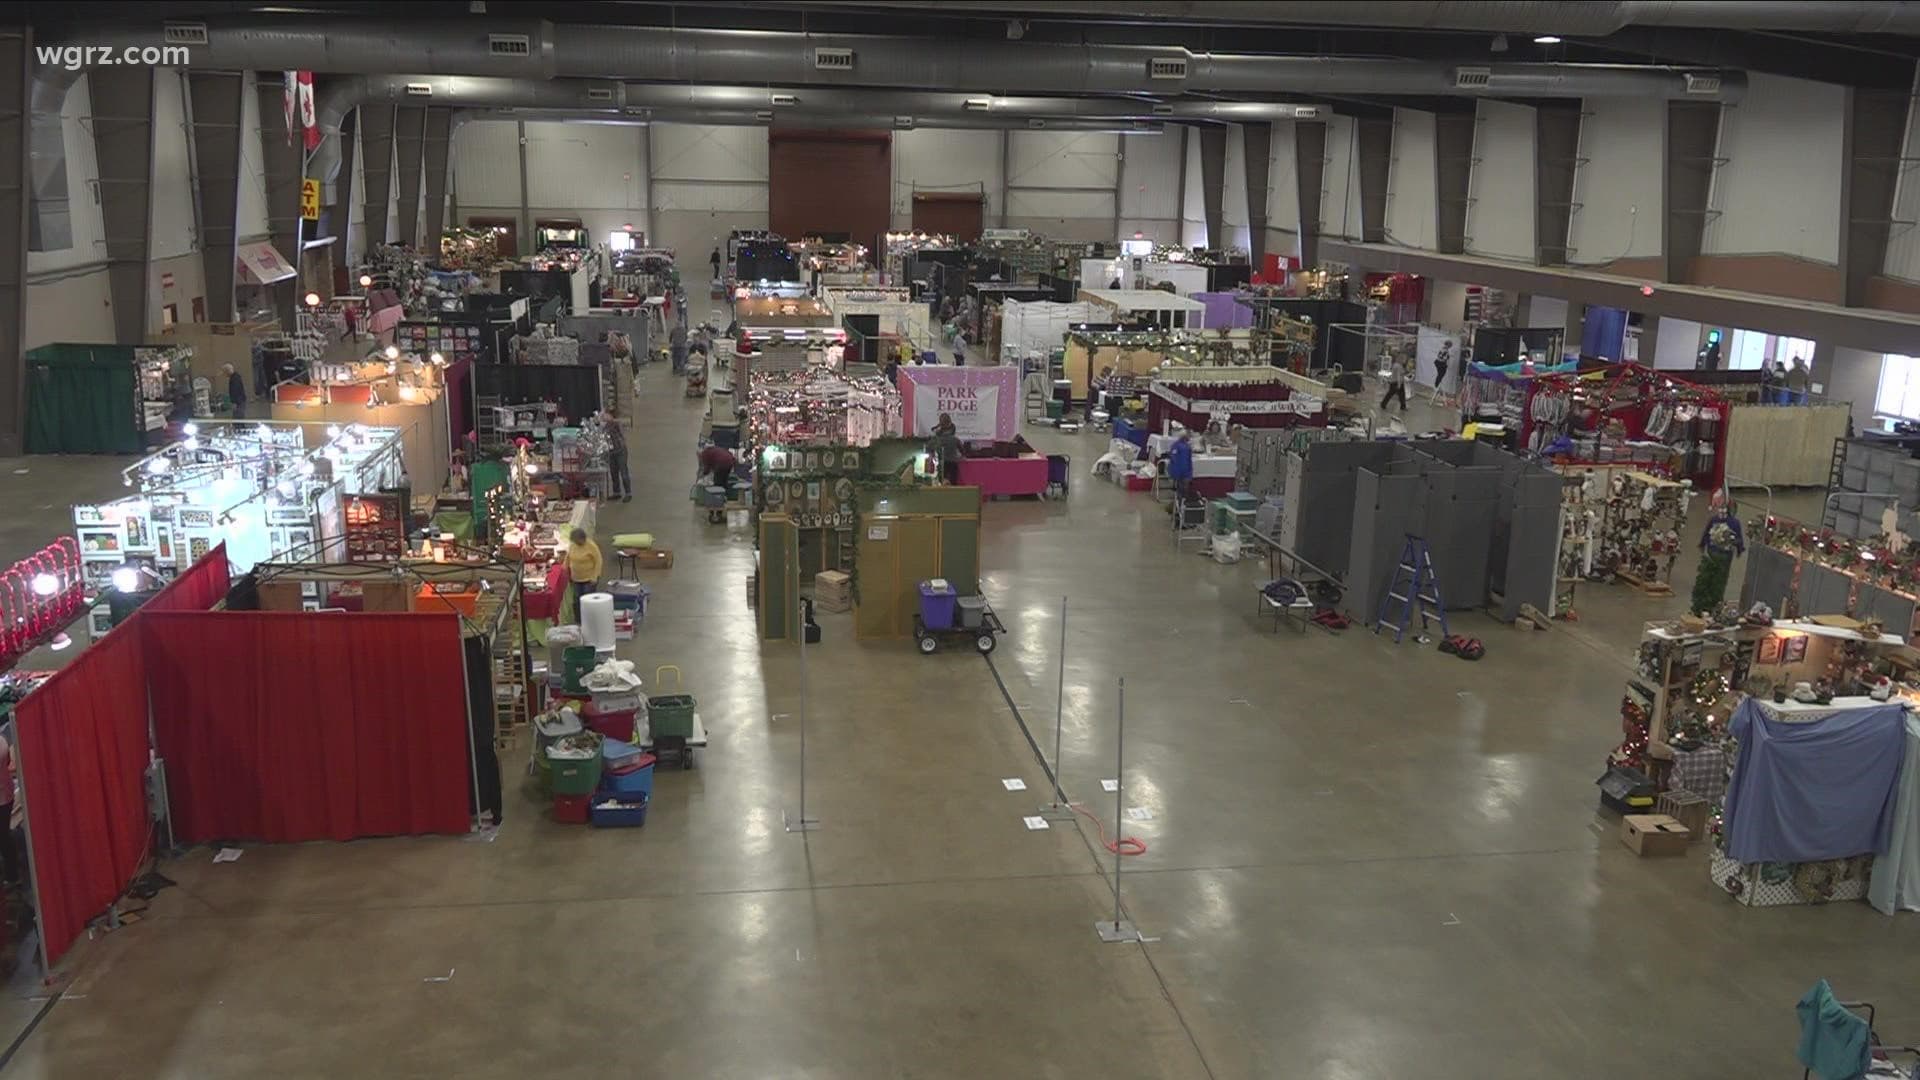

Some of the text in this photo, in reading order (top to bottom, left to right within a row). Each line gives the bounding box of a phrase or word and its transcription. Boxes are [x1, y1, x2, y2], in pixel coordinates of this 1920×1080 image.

[303, 181, 315, 217] ATM
[938, 387, 977, 399] PARK
[937, 400, 978, 412] EDGE
